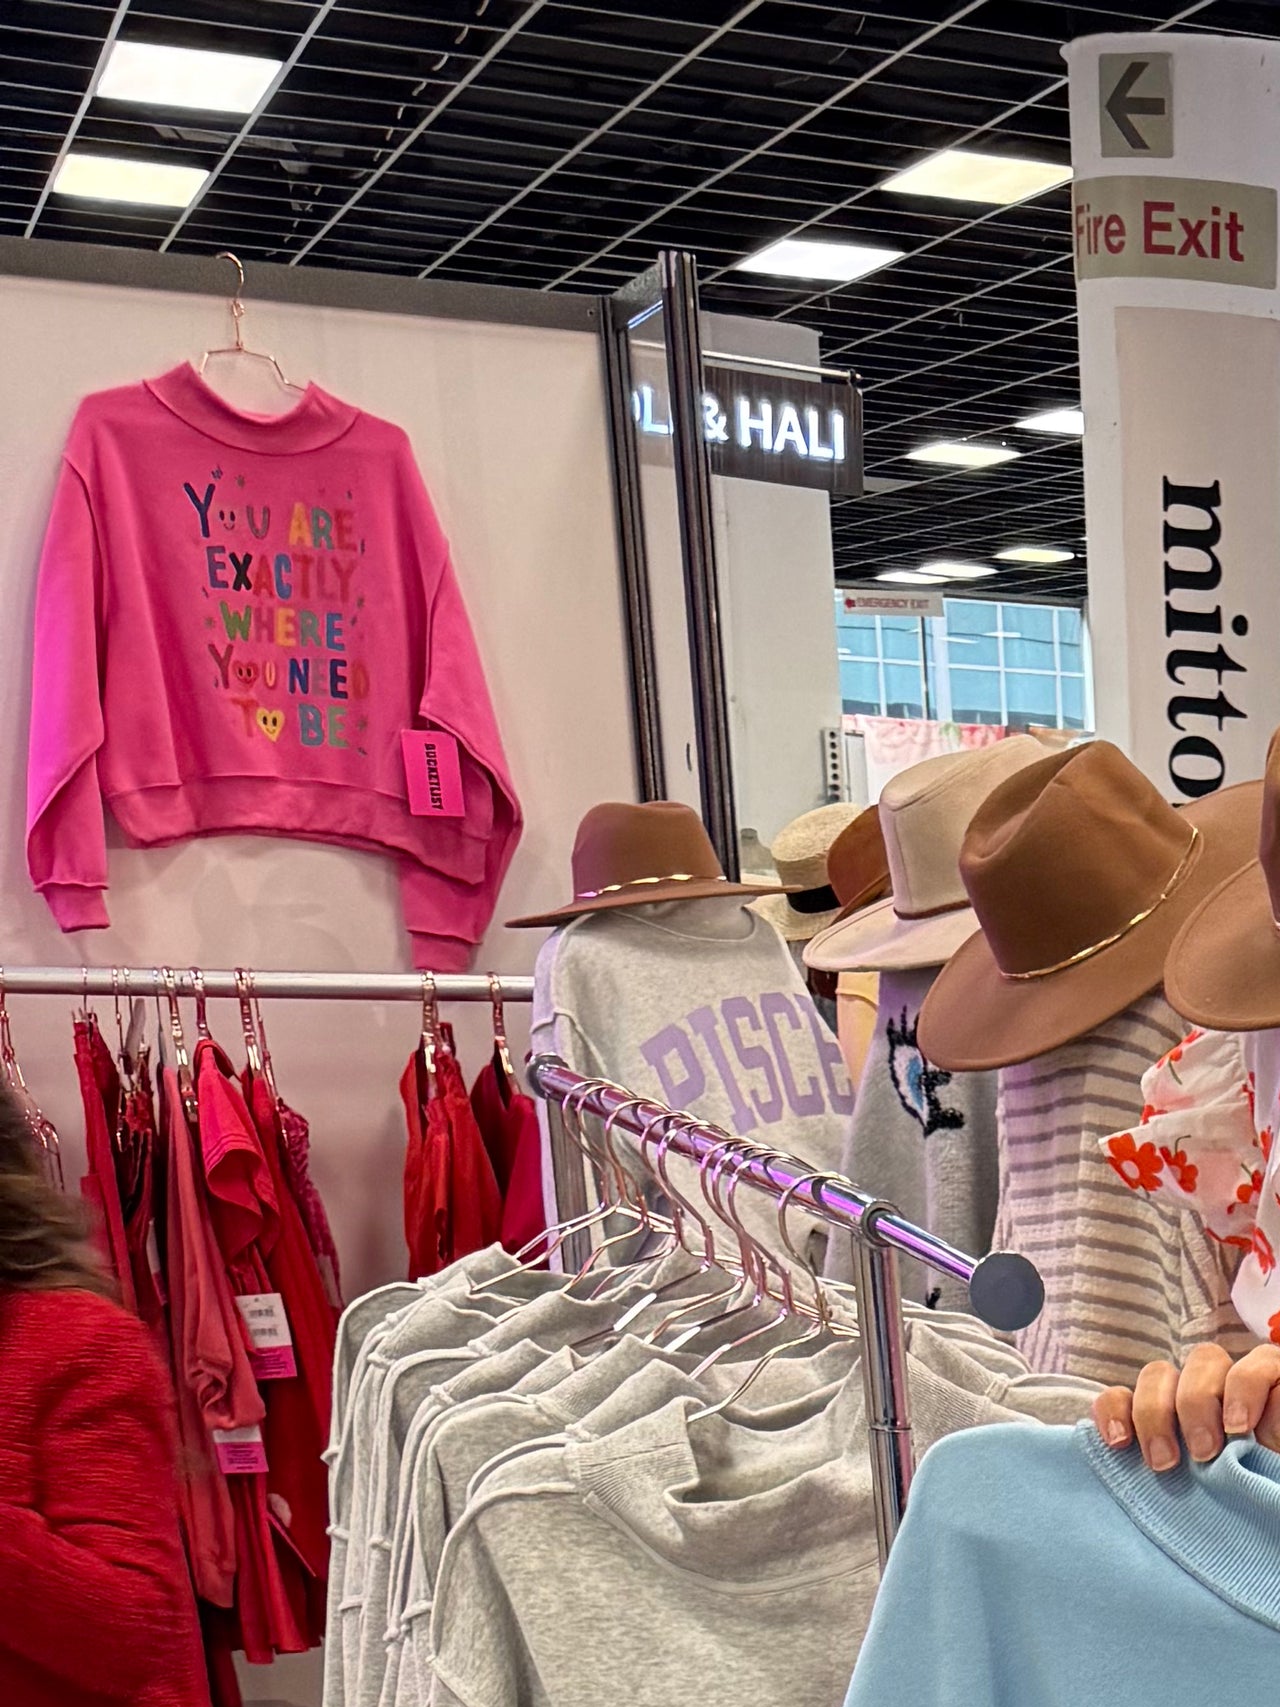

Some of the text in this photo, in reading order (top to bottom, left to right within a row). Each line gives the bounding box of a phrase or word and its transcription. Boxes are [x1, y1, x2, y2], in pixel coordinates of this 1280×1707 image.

[1075, 201, 1244, 262] Fire Exit
[738, 396, 845, 460] HALI
[289, 502, 358, 552] ARE
[206, 545, 358, 602] EXACTLY
[219, 601, 346, 651] WHERE
[289, 658, 370, 700] NEED
[298, 703, 348, 748] BE
